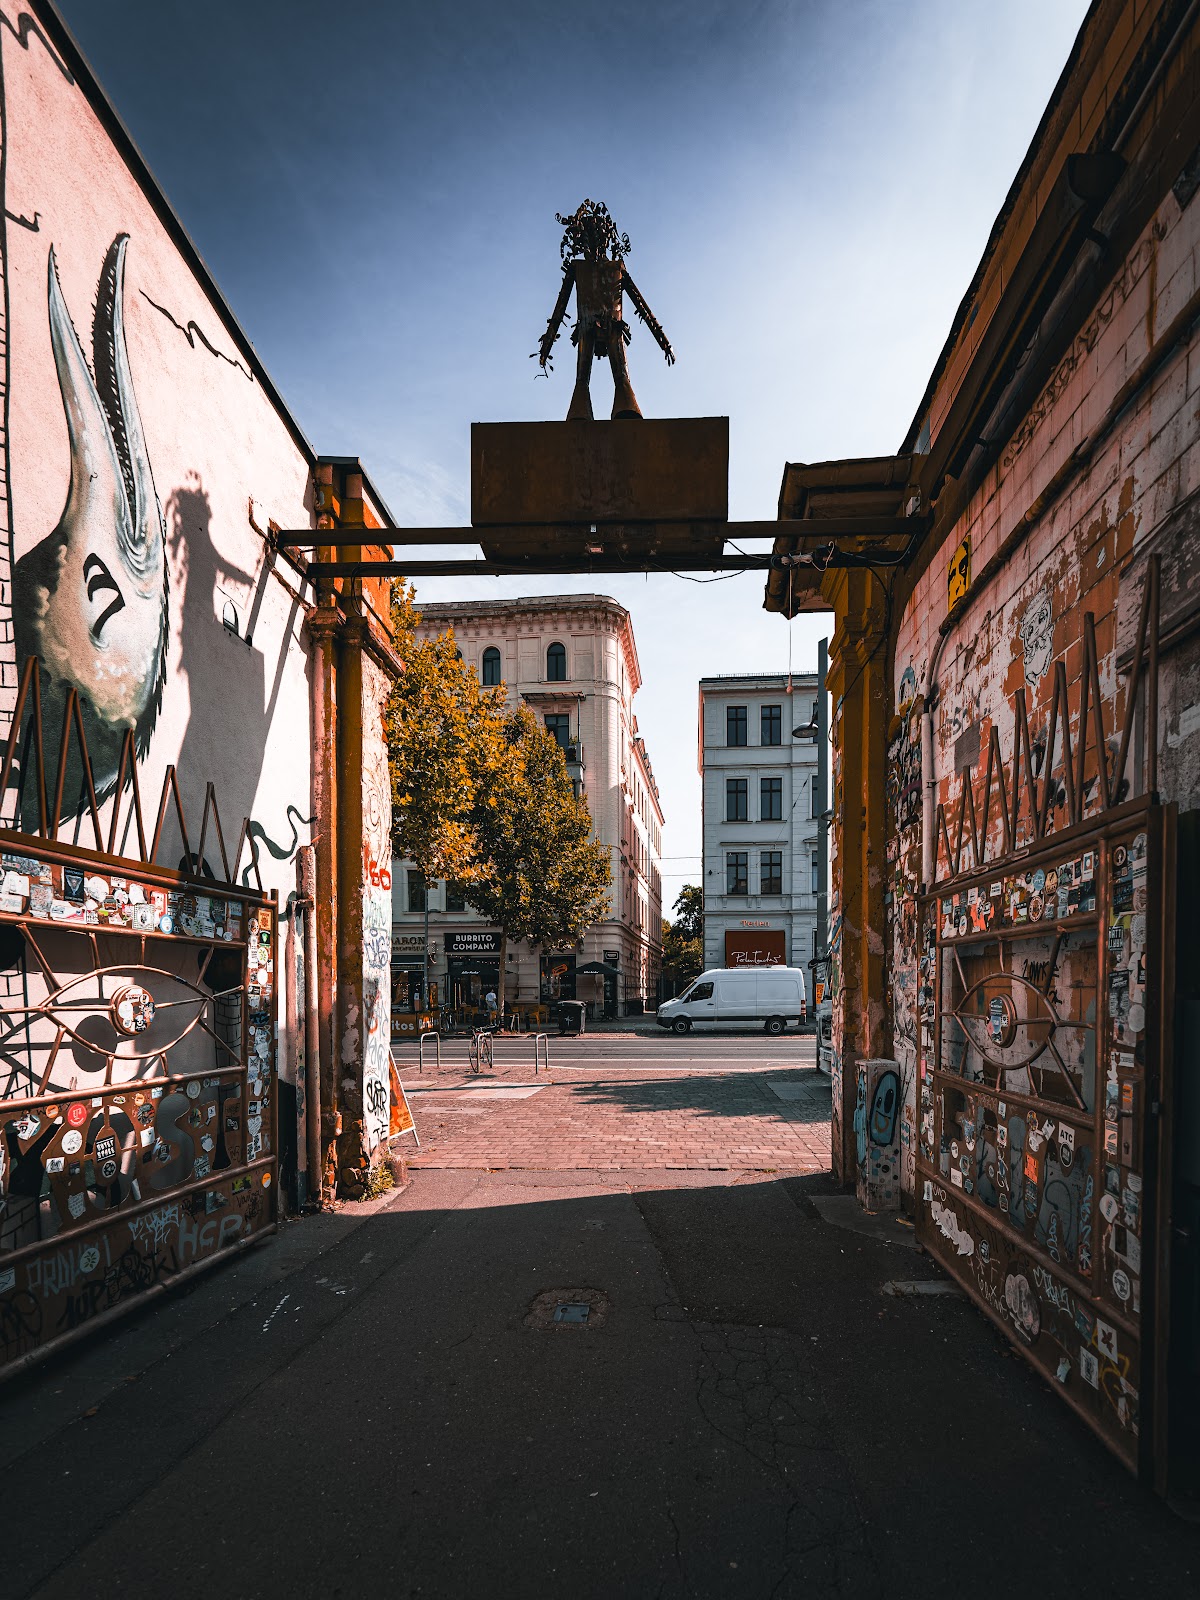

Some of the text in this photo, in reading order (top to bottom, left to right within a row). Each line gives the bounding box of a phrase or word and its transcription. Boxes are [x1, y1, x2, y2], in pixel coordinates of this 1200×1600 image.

[455, 934, 493, 942] BURRITO
[452, 943, 496, 951] COMPANY
[1060, 1129, 1073, 1143] ATC
